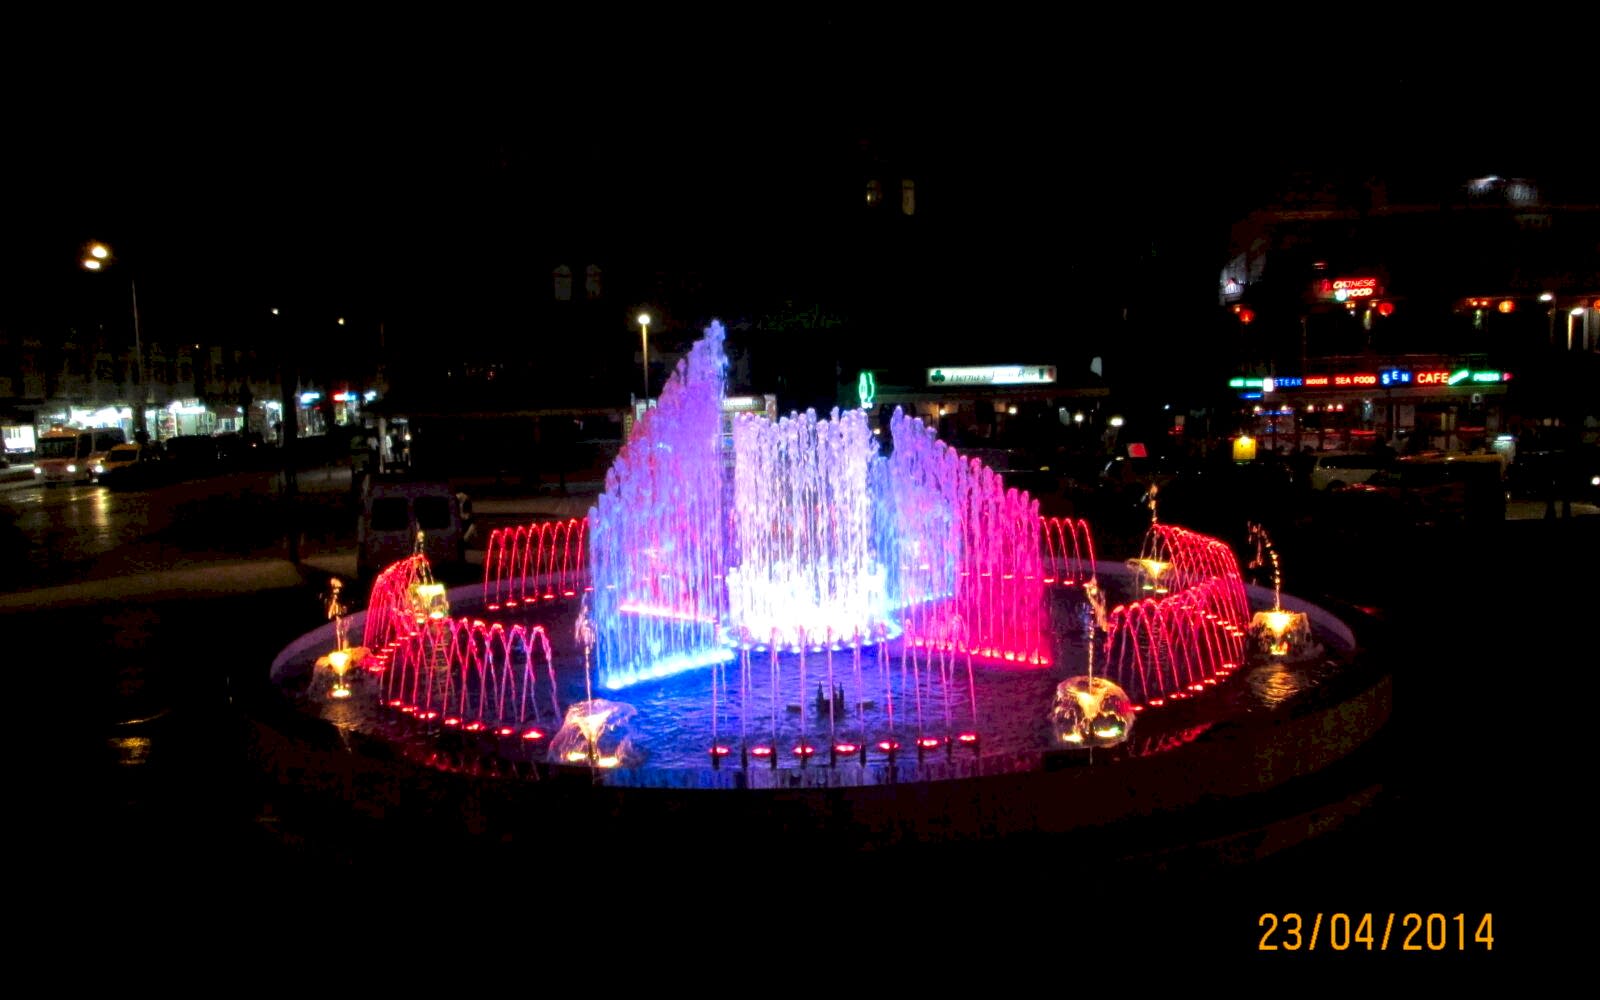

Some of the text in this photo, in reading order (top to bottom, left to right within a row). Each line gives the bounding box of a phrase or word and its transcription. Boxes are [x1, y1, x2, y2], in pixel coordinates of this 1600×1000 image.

[1346, 288, 1373, 297] FOOD
[1274, 378, 1303, 387] STEAK
[1335, 375, 1376, 385] SEA FOOD
[1382, 370, 1409, 385] SEN
[1417, 372, 1449, 384] CAFE
